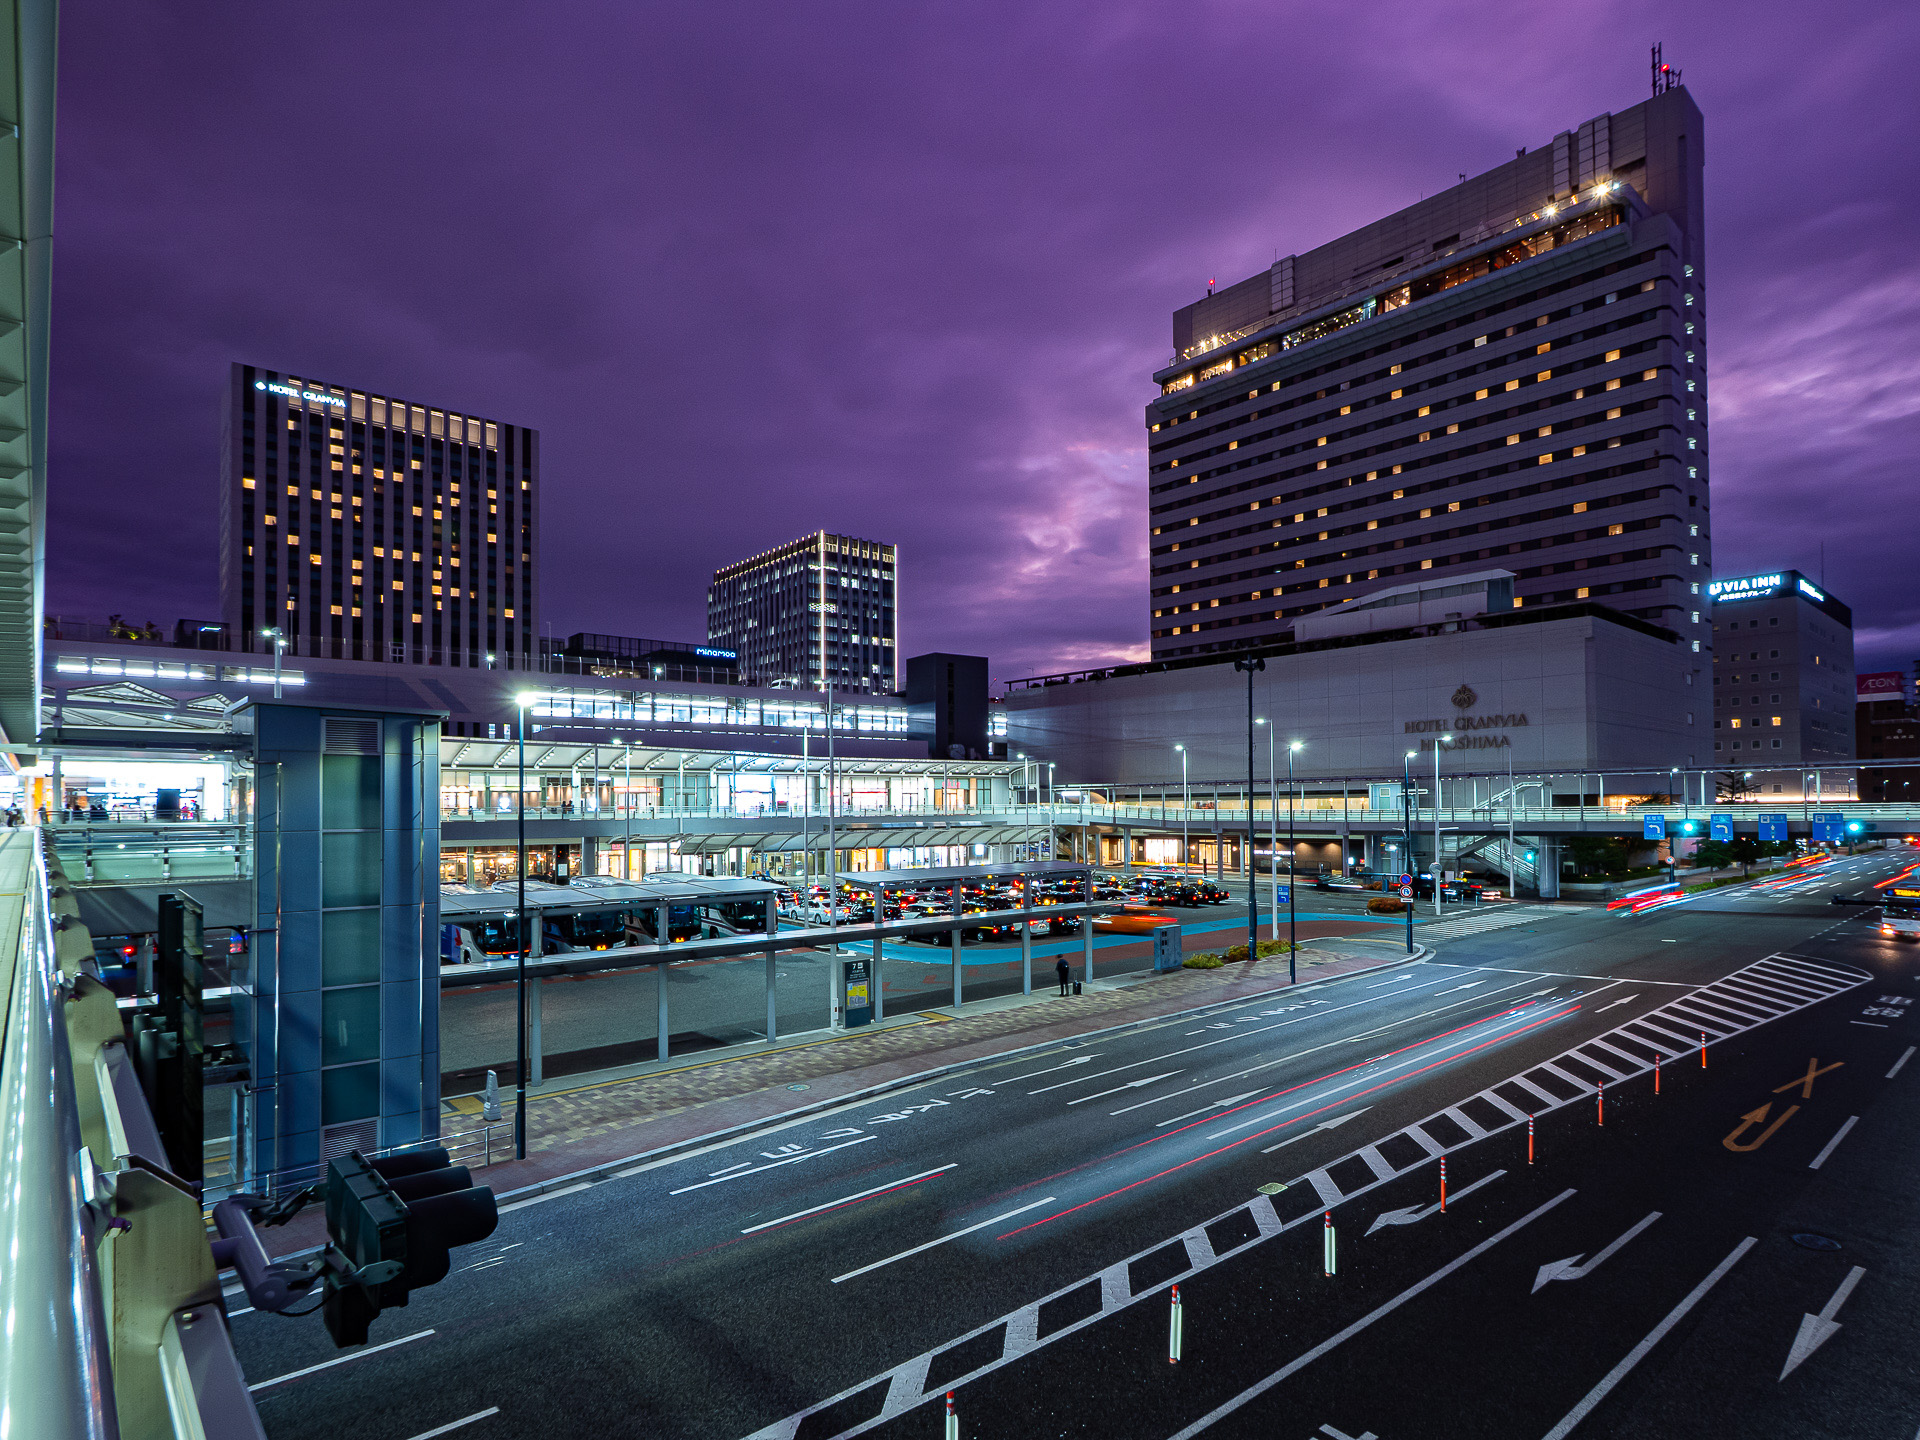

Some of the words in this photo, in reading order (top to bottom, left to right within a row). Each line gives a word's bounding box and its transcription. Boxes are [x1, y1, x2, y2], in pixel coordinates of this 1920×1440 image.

[269, 383, 300, 397] HOTEL
[302, 391, 346, 407] GRANVIA
[1723, 579, 1749, 592] VIA
[1752, 575, 1780, 588] INN
[696, 648, 736, 658] minamoa
[1405, 718, 1449, 733] HOTEL
[1454, 712, 1528, 730] GRANVIA
